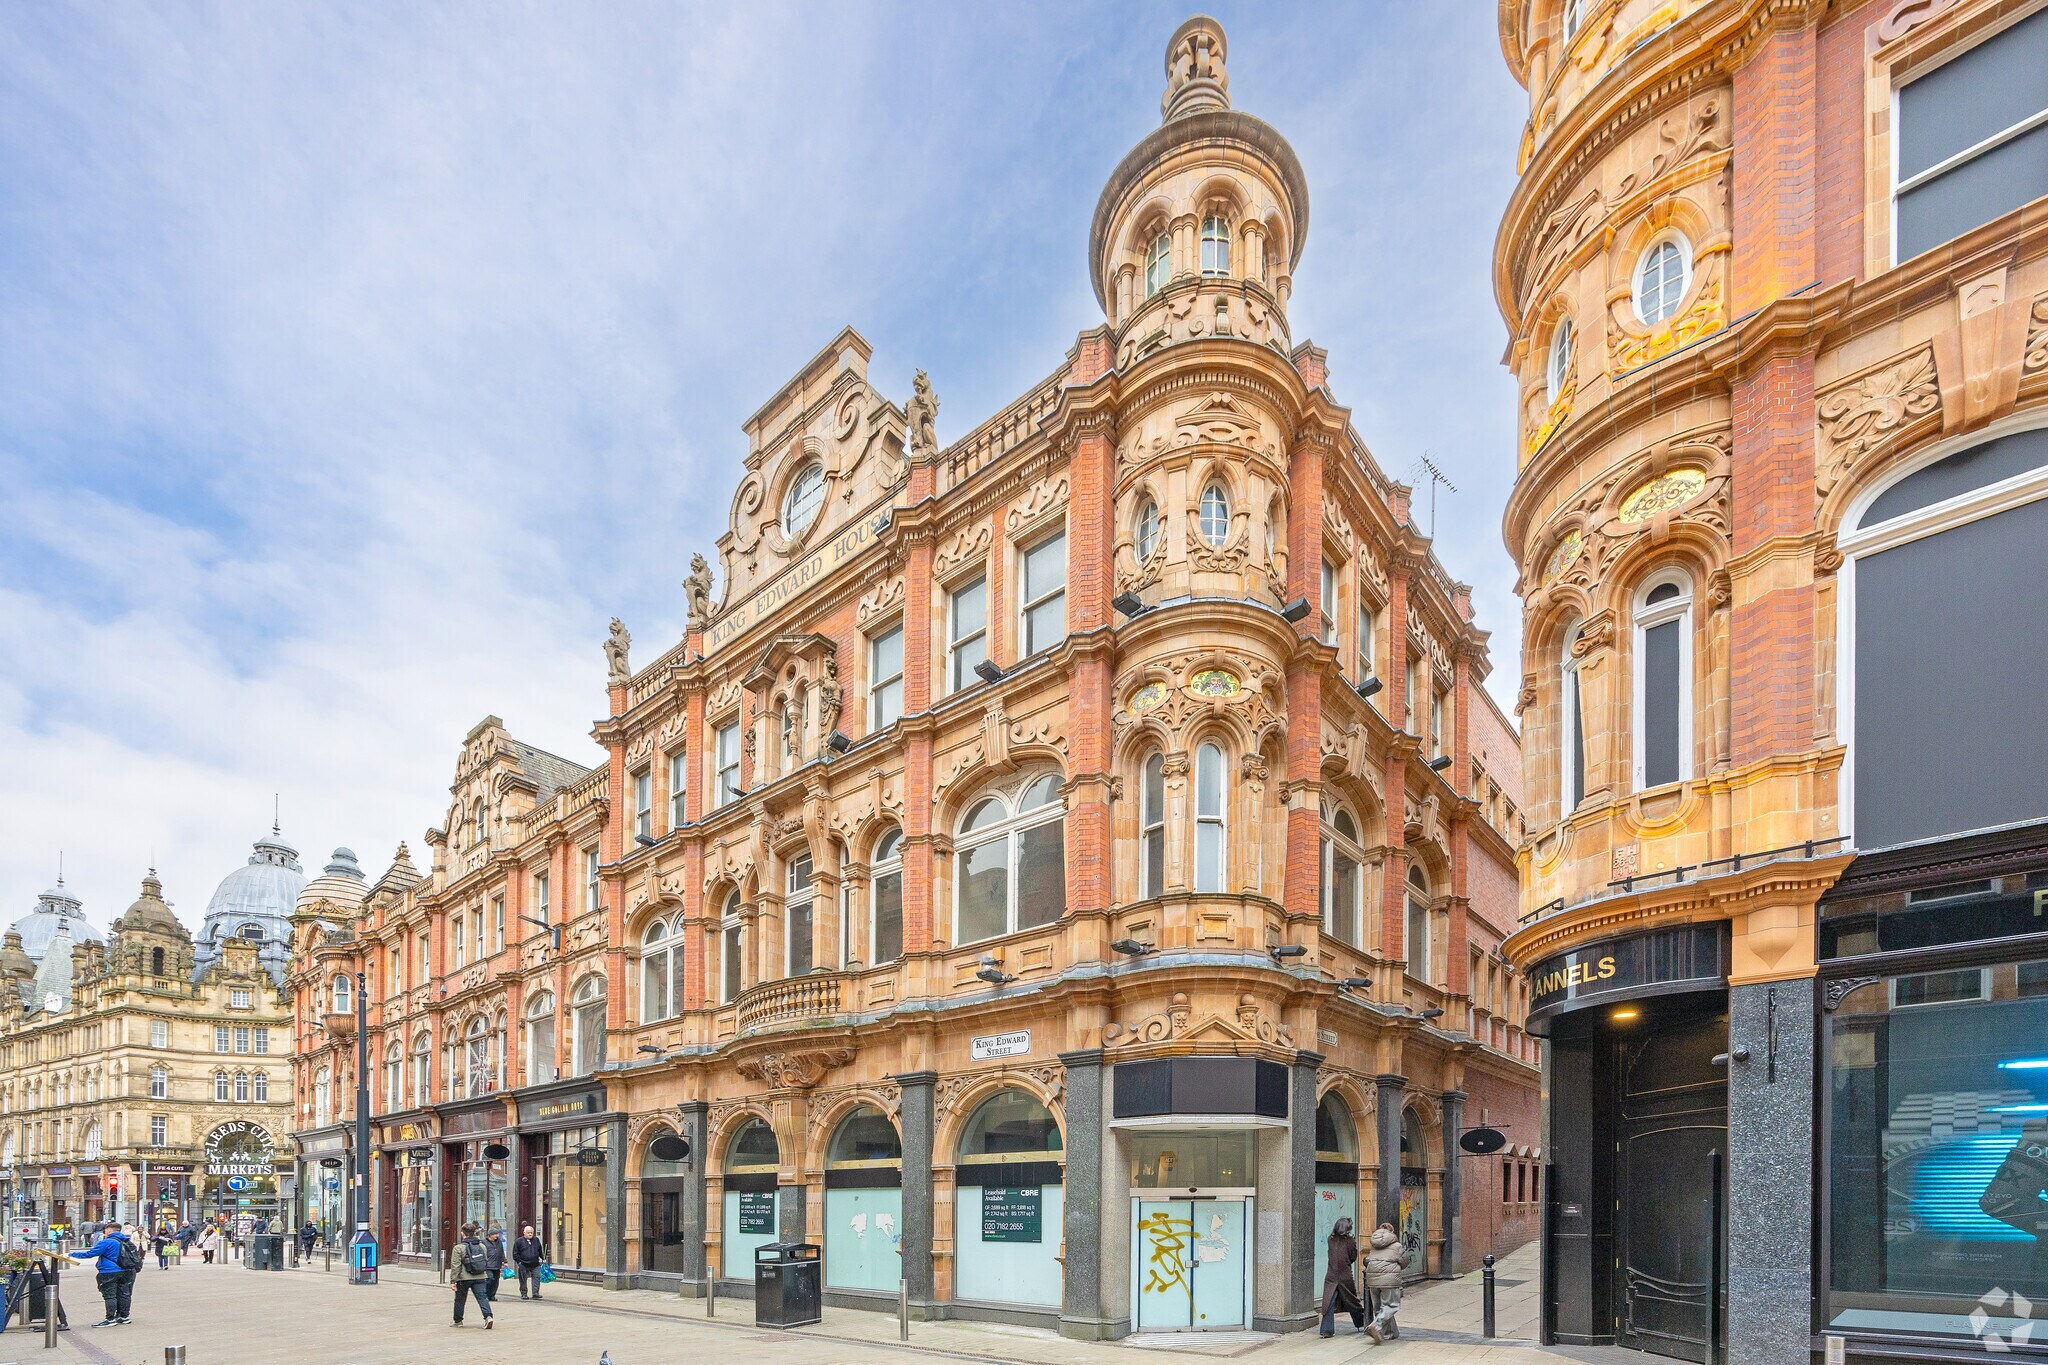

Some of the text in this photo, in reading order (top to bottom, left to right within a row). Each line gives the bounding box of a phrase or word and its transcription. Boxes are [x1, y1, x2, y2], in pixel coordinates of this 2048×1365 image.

[711, 609, 746, 646] KING
[756, 556, 822, 616] EDWARD
[996, 1035, 1027, 1046] EDWARD
[986, 1047, 1012, 1056] STREET
[539, 1101, 584, 1116] BLUE COLLAR BOYS
[205, 1121, 275, 1148] LEEDS CITY
[411, 1149, 431, 1157] VANS
[208, 1164, 272, 1175] MARKETS
[1020, 1189, 1039, 1197] CBRE
[984, 1222, 1024, 1231] 020 7182 2655
